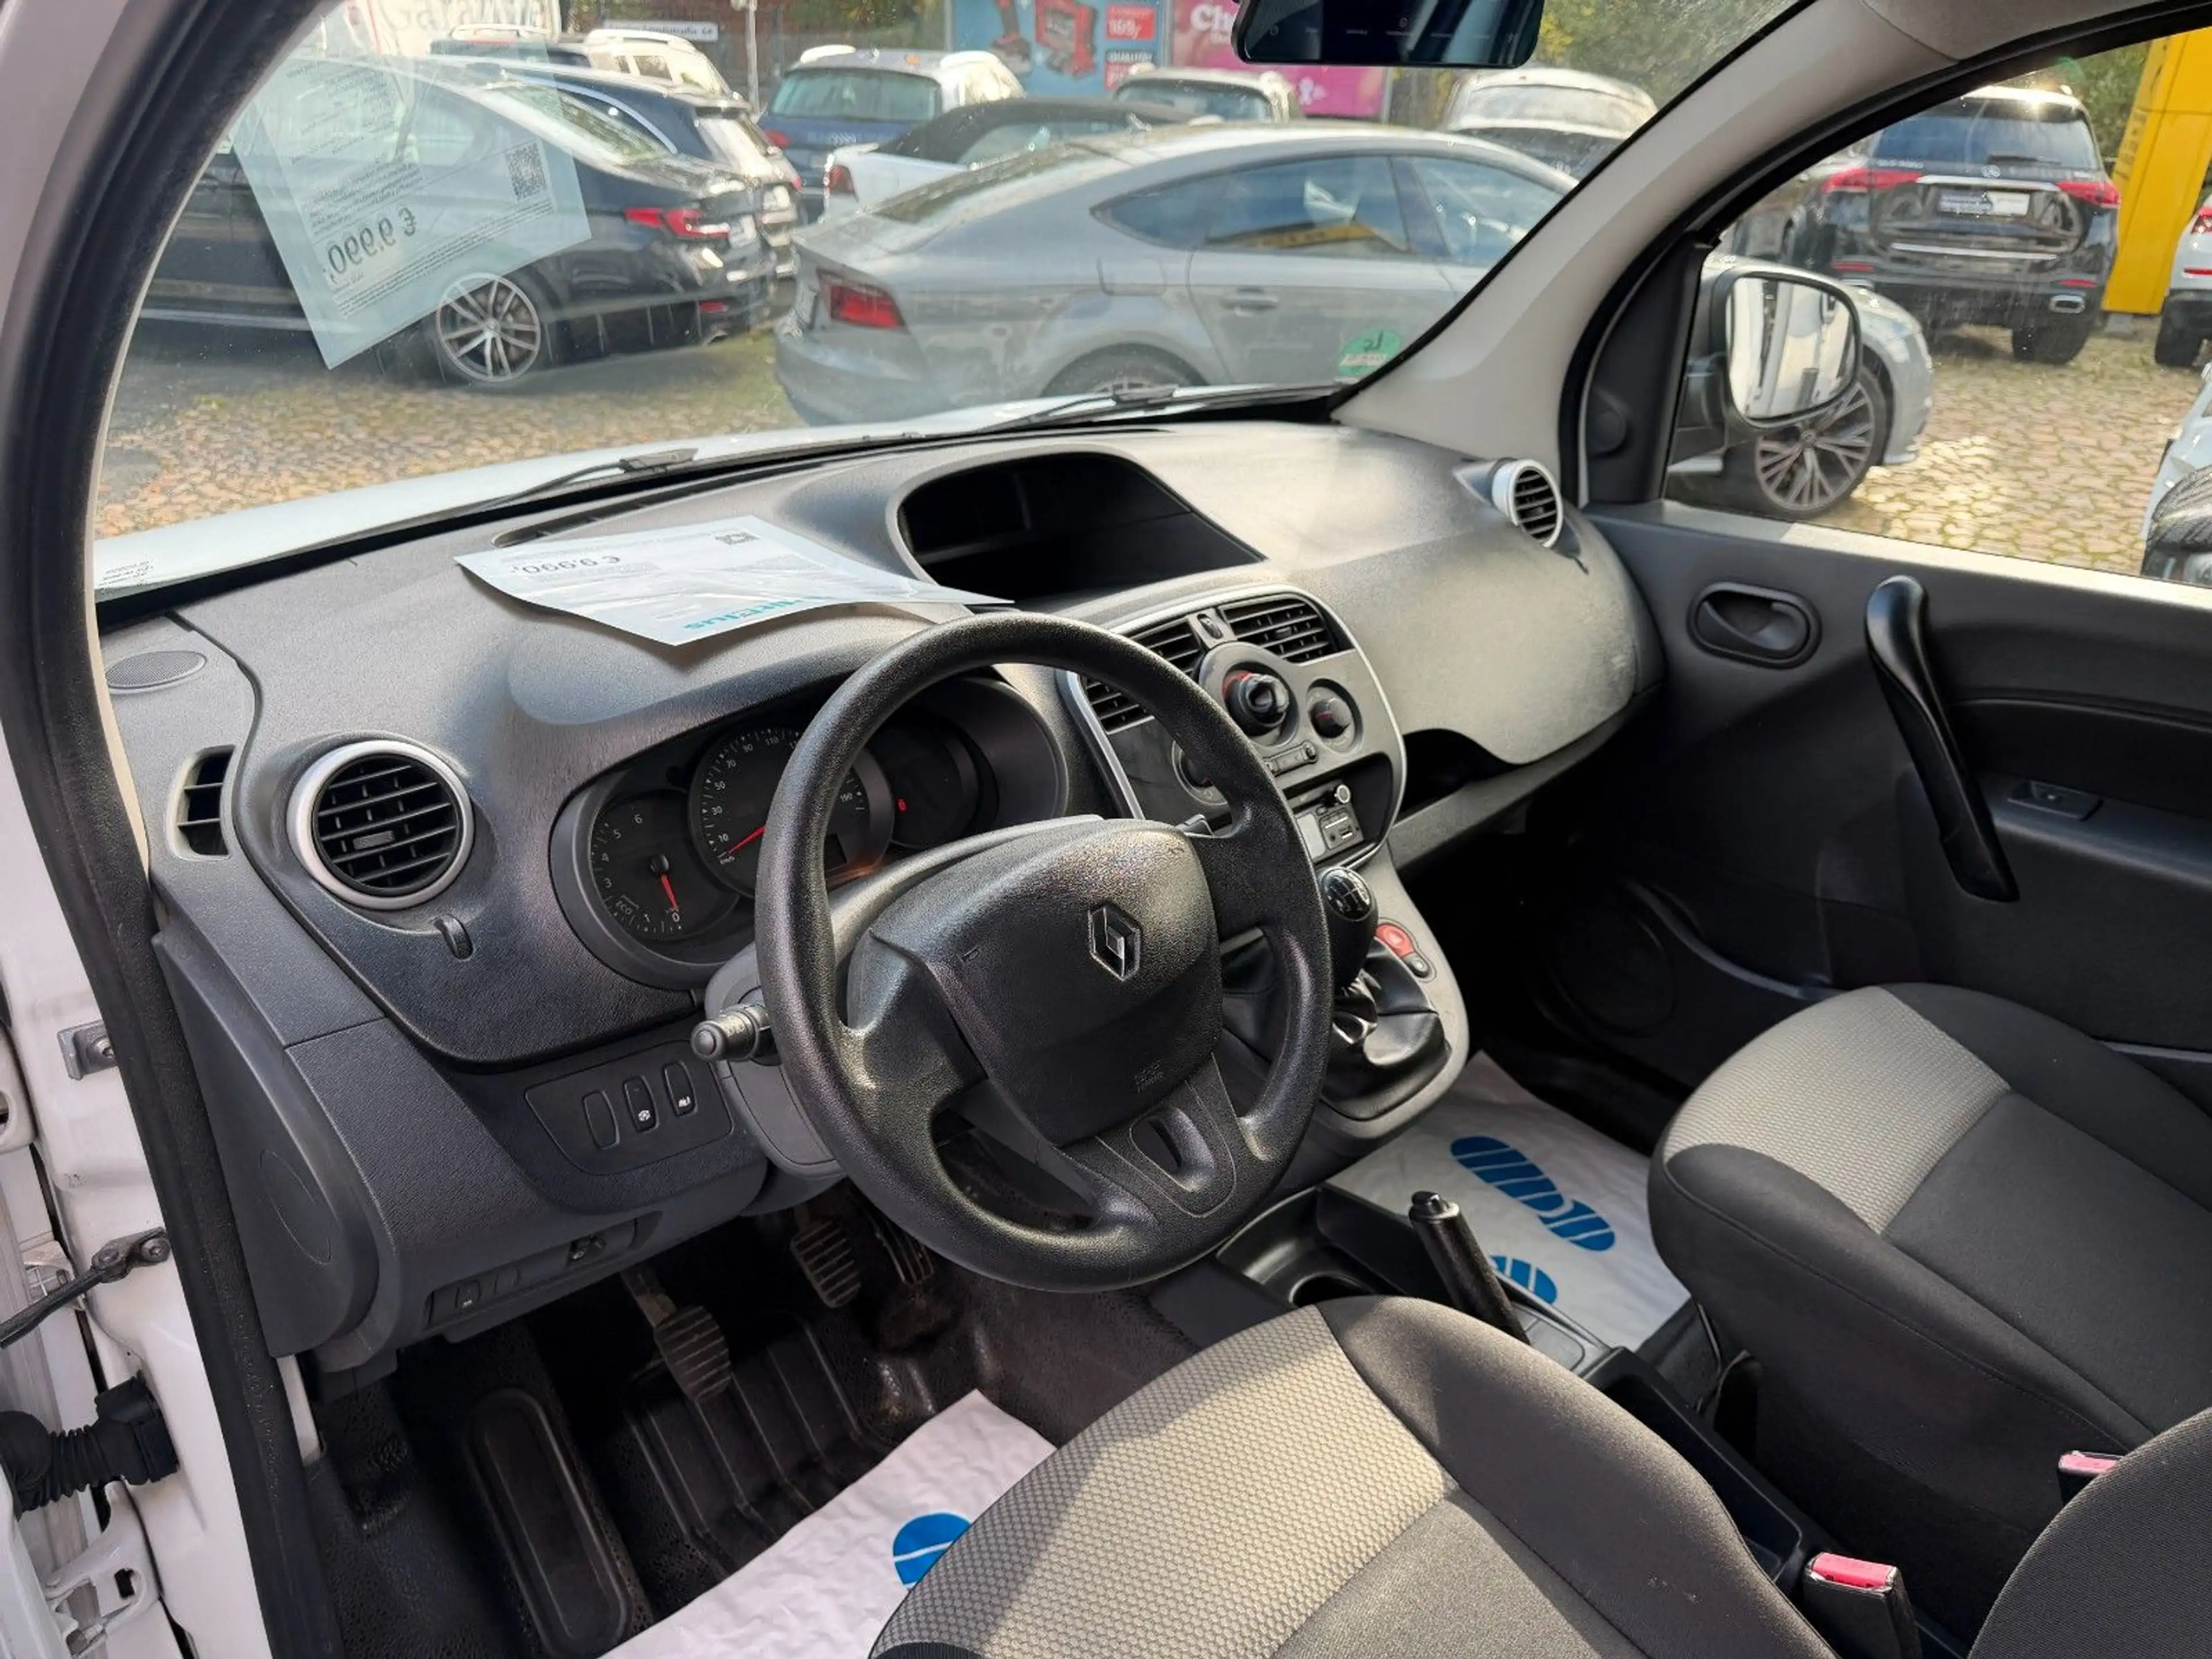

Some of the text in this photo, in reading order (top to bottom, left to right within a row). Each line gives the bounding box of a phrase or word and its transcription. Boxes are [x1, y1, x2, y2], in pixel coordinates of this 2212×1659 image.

[726, 759, 736, 768] 70
[714, 781, 726, 790] 50
[711, 805, 723, 815] 30
[634, 813, 643, 824] 6
[613, 829, 622, 839] 5
[718, 833, 729, 843] 10
[601, 853, 609, 862] 4
[604, 878, 612, 888] 3
[672, 912, 680, 923] 0
